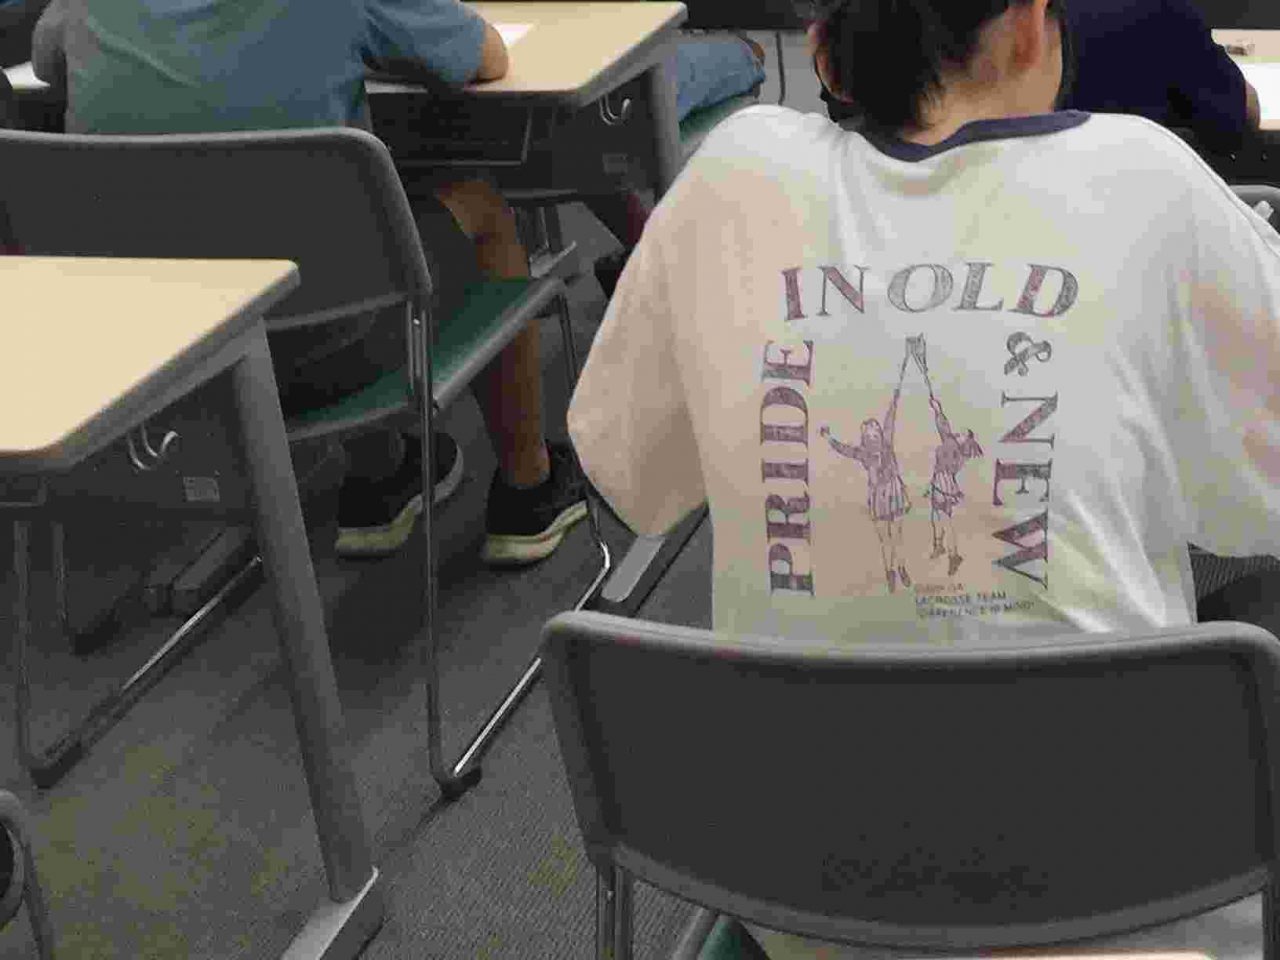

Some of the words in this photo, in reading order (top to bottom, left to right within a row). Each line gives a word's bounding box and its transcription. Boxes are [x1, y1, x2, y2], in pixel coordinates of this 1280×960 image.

[780, 264, 869, 322] IN
[886, 261, 1079, 319] OLD
[1003, 331, 1053, 377] &
[759, 339, 815, 597] PRIDE
[991, 390, 1059, 590] NEW
